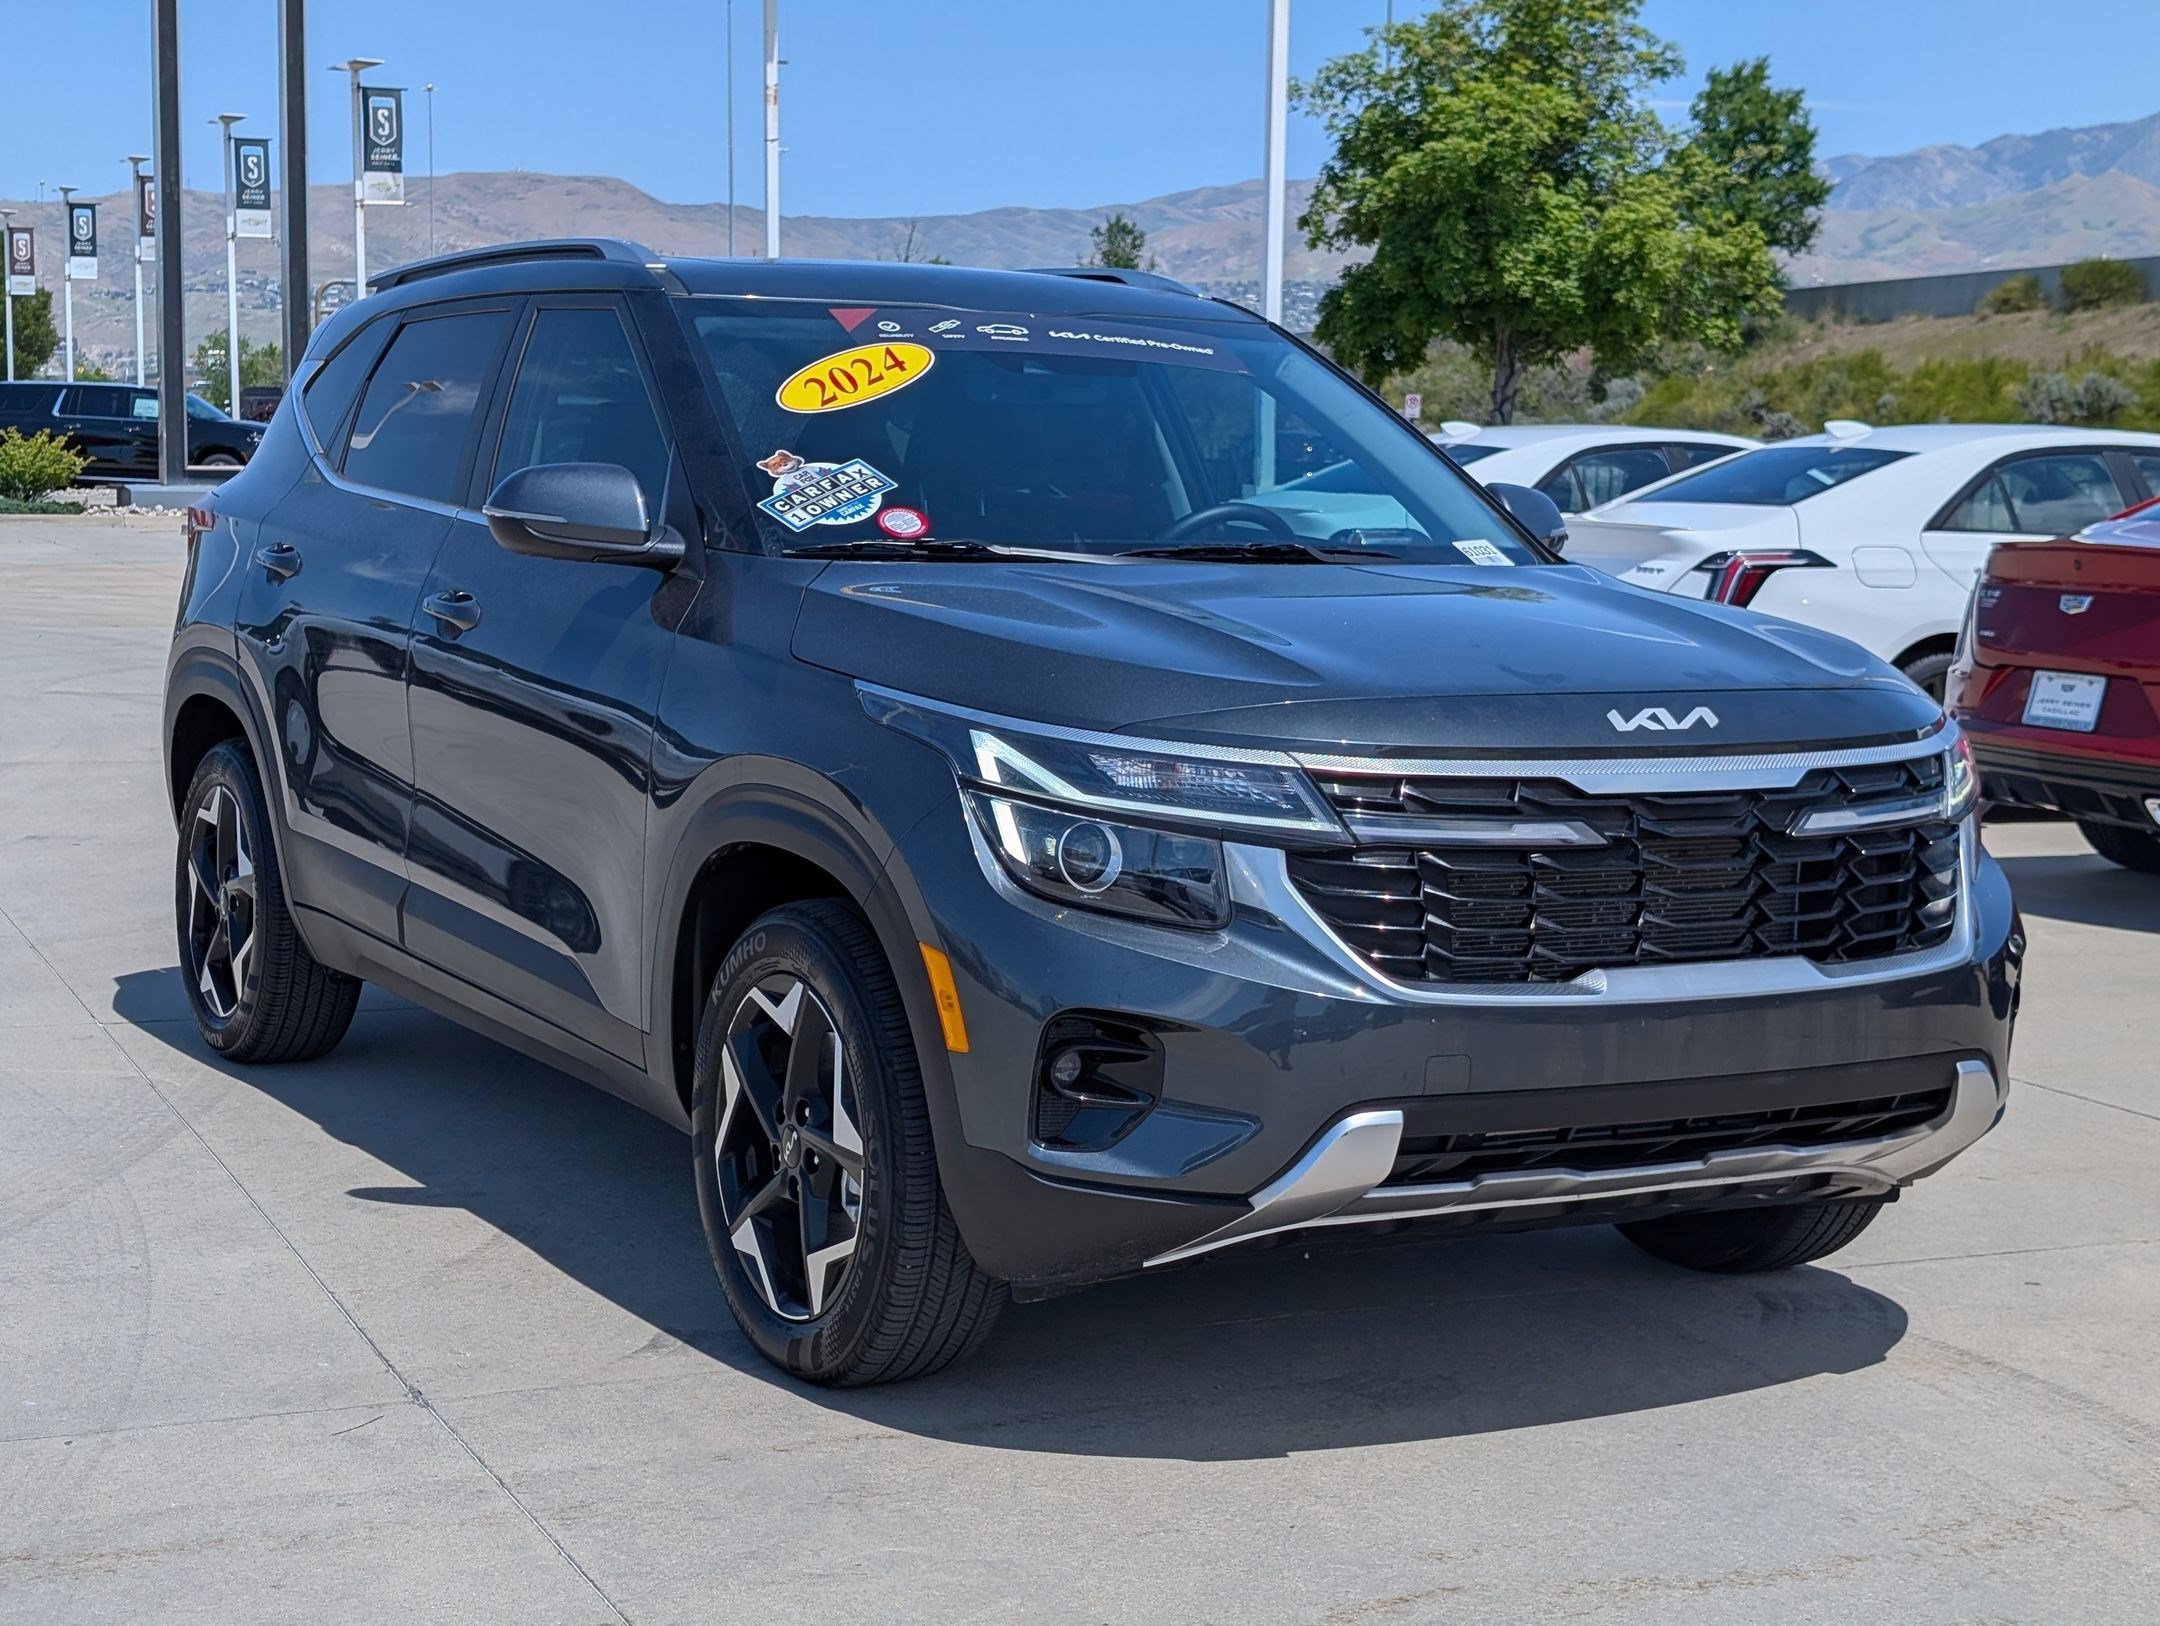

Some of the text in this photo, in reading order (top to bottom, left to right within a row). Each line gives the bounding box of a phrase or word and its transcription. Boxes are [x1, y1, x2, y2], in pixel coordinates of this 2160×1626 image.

[377, 108, 390, 136] S
[247, 155, 259, 179] S
[1093, 334, 1147, 346] Certified
[1147, 339, 1214, 355] Pre-Owned
[804, 347, 907, 407] 2024
[793, 470, 811, 480] CAR
[800, 475, 816, 485] FOX
[774, 468, 870, 513] CARFAX
[1461, 545, 1498, 557] 61031
[1606, 706, 1719, 731] KIA
[711, 931, 767, 1007] KUMHO
